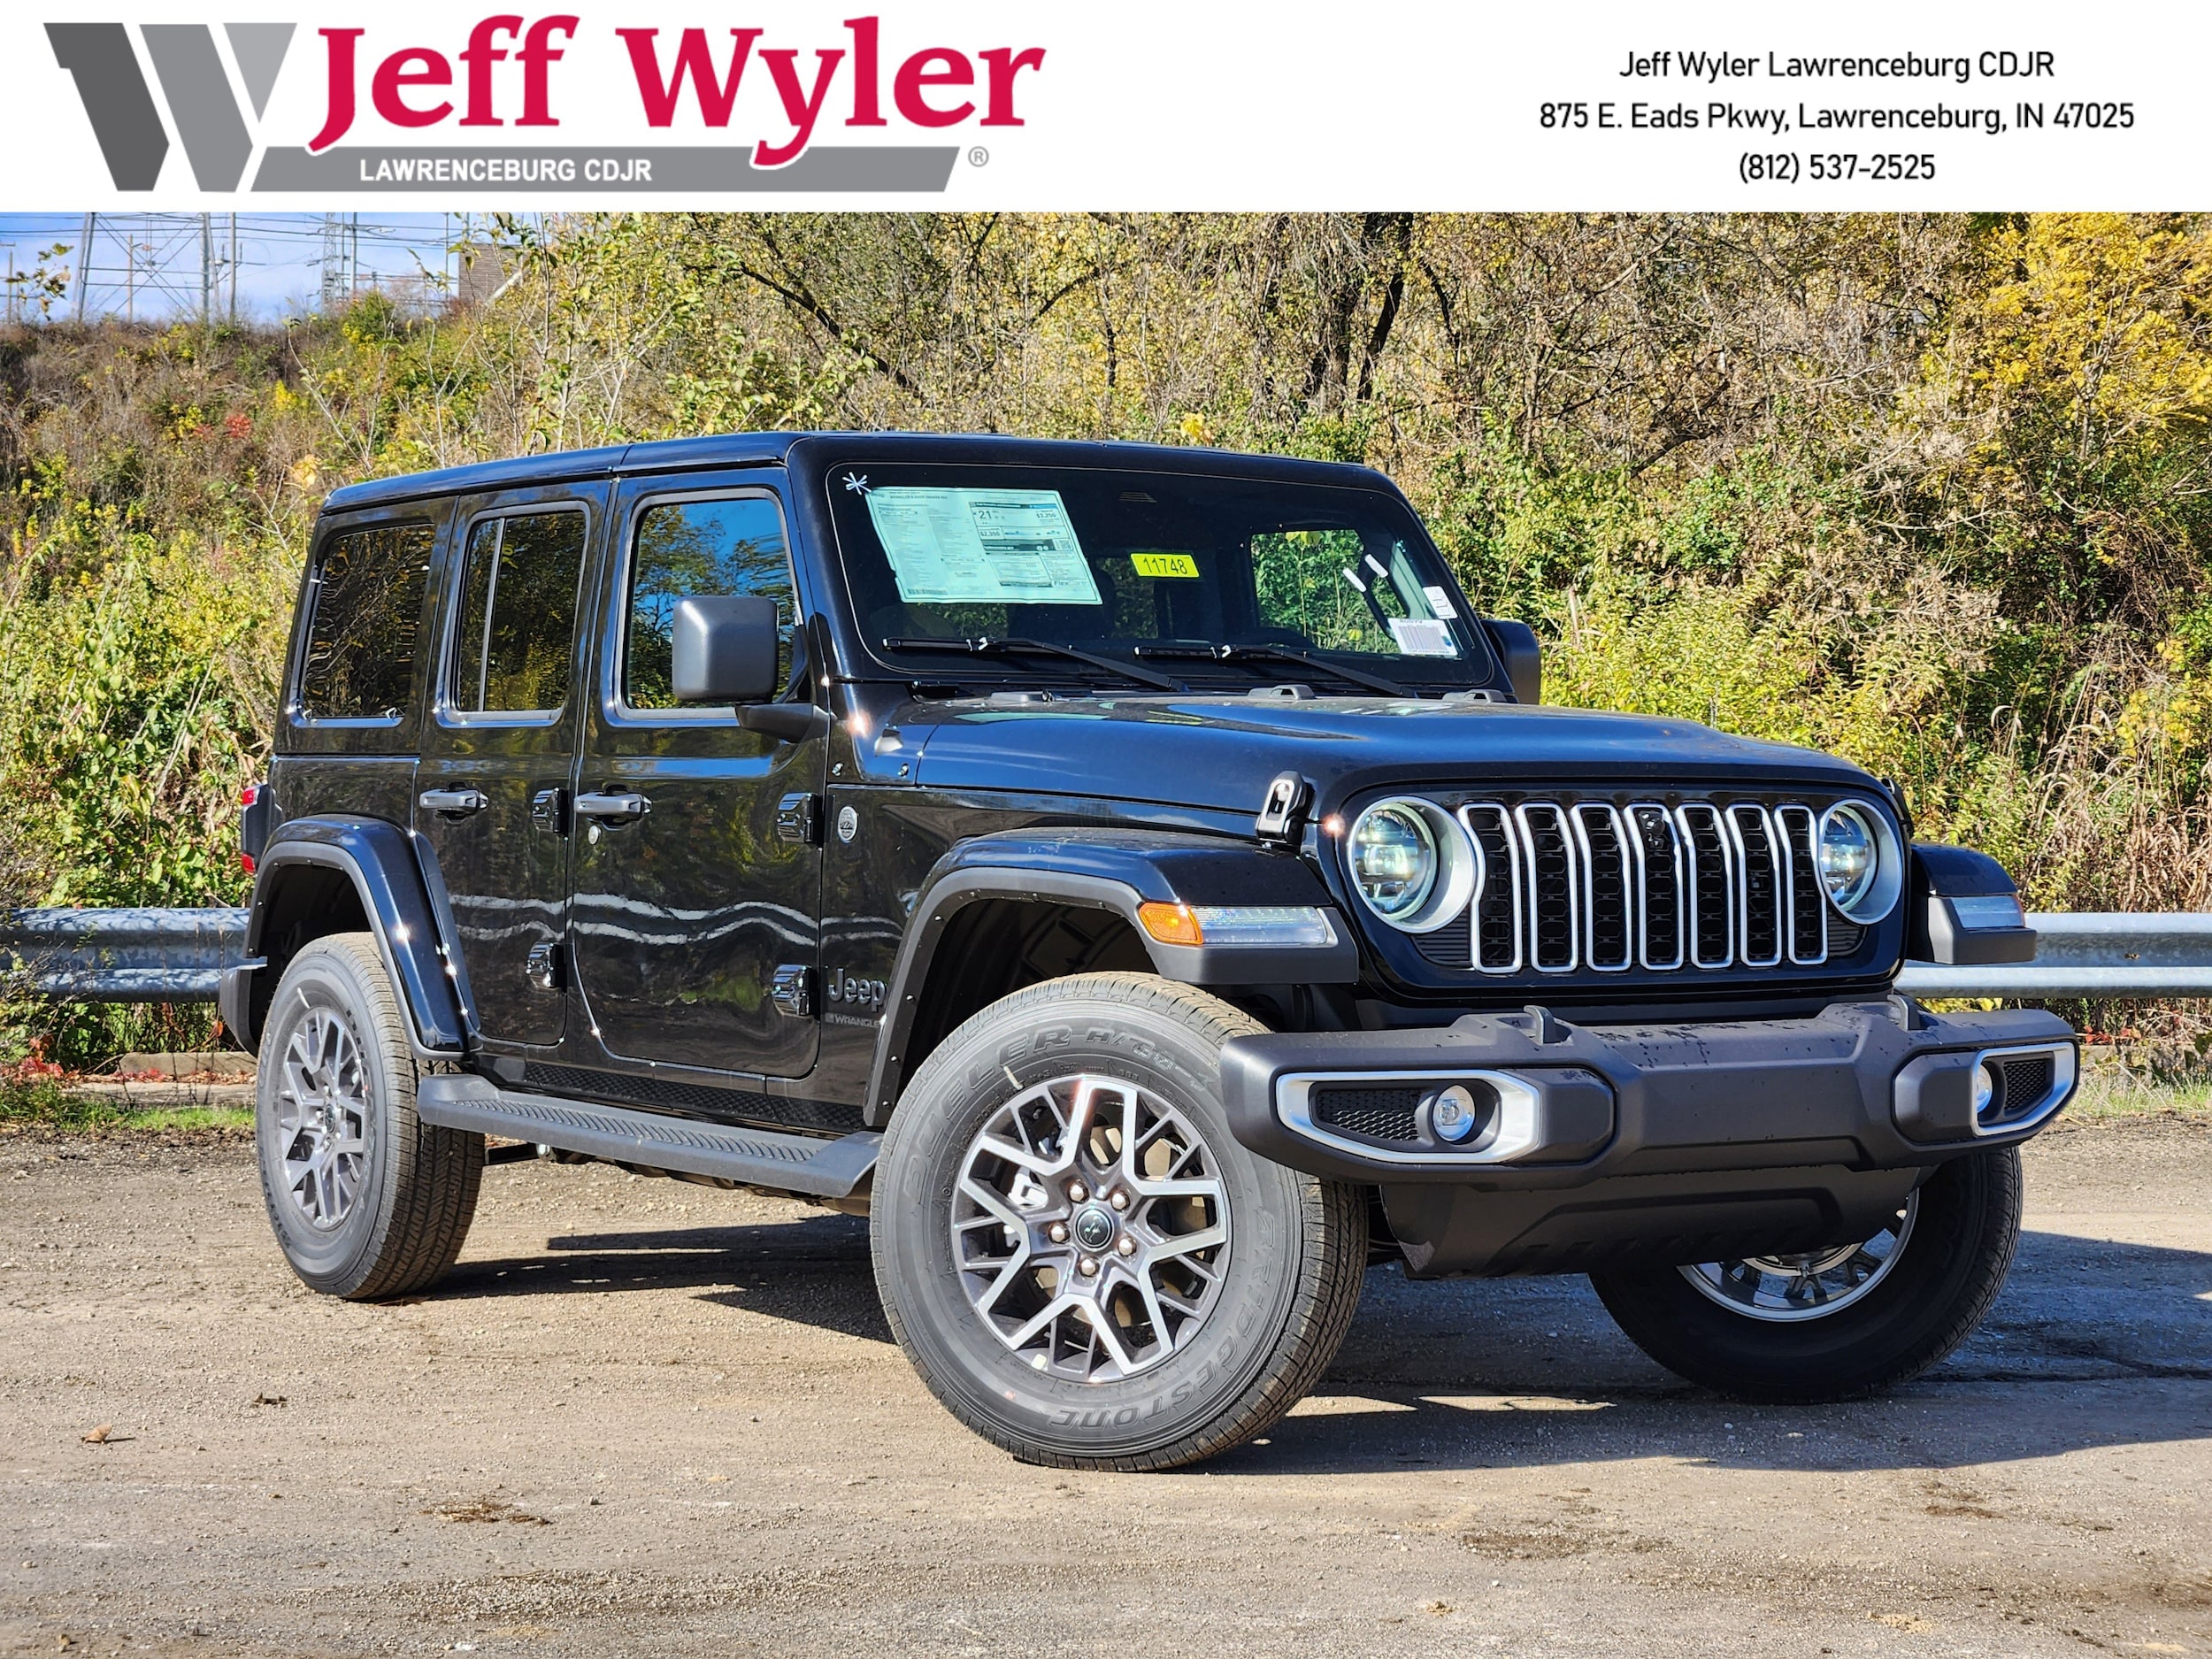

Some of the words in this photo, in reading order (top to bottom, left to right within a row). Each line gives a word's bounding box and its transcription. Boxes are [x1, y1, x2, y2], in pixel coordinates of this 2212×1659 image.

[978, 510, 992, 519] 21
[1143, 557, 1187, 574] 11748
[828, 967, 887, 1012] Jeep
[834, 1013, 884, 1028] WRANGLE
